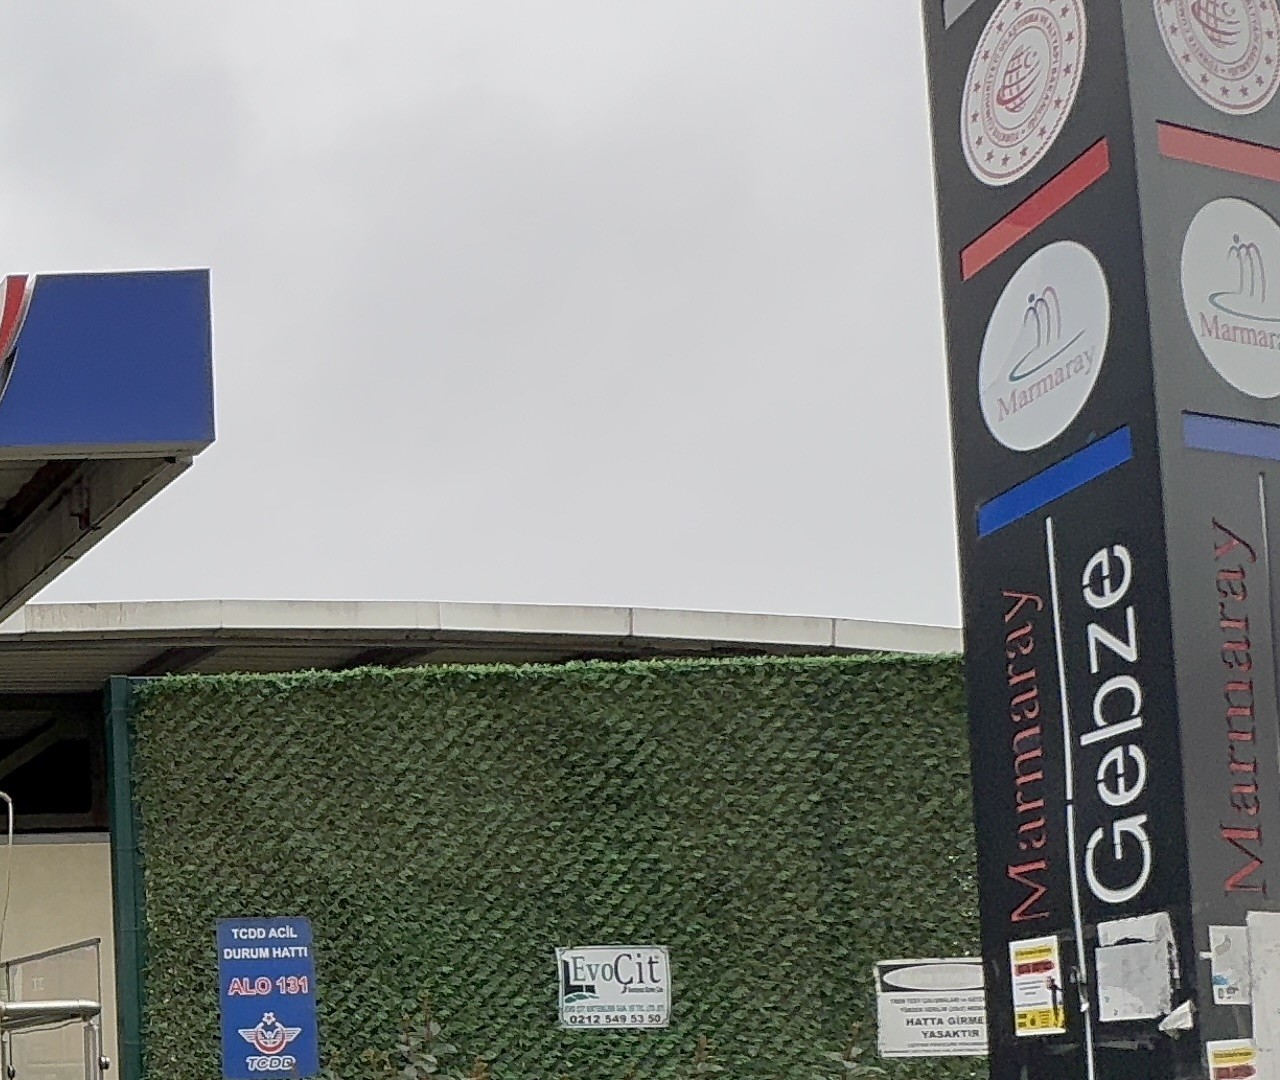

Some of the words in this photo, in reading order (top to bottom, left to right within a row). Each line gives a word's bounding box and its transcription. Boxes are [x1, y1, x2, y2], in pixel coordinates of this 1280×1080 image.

[1198, 311, 1280, 350] Marmar
[997, 345, 1097, 424] Marmaray
[1212, 516, 1268, 896] Marmaray
[1080, 542, 1153, 903] Gebze
[1001, 590, 1049, 923] Marmaray
[231, 928, 265, 939] TCDD
[269, 925, 298, 939] ACİL
[223, 948, 269, 960] DURUM
[272, 947, 308, 959] HATTI
[228, 977, 272, 996] ALO
[276, 976, 309, 995] 131
[570, 1015, 601, 1024] 0212
[605, 1014, 627, 1024] 549
[906, 1017, 945, 1027] HATTA
[947, 1014, 984, 1026] GİRME
[921, 1029, 980, 1039] YASAKTIR
[246, 1056, 297, 1072] TCDD
